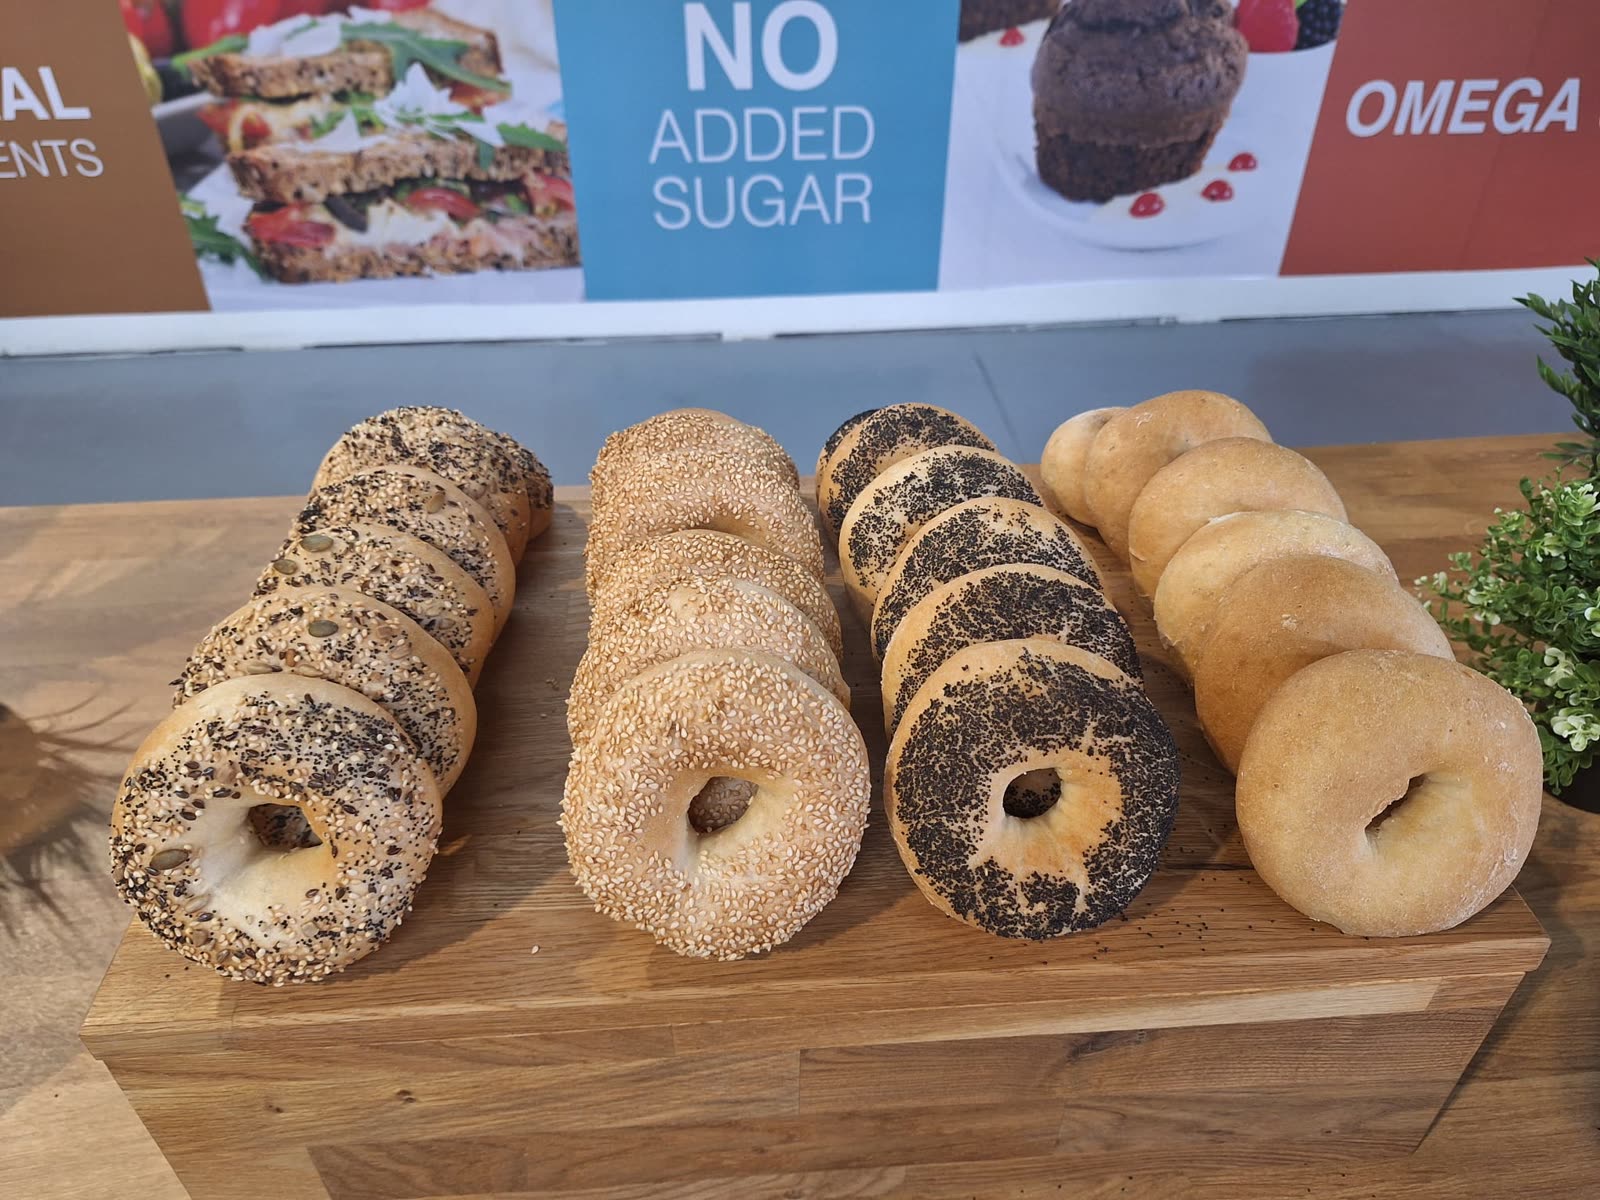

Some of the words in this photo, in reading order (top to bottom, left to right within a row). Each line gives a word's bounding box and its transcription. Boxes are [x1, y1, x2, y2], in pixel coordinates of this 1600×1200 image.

[684, 0, 838, 91] NO
[0, 66, 91, 120] AL
[1346, 77, 1580, 137] OMEGA
[649, 105, 875, 164] ADDED
[652, 173, 873, 230] SUGAR
